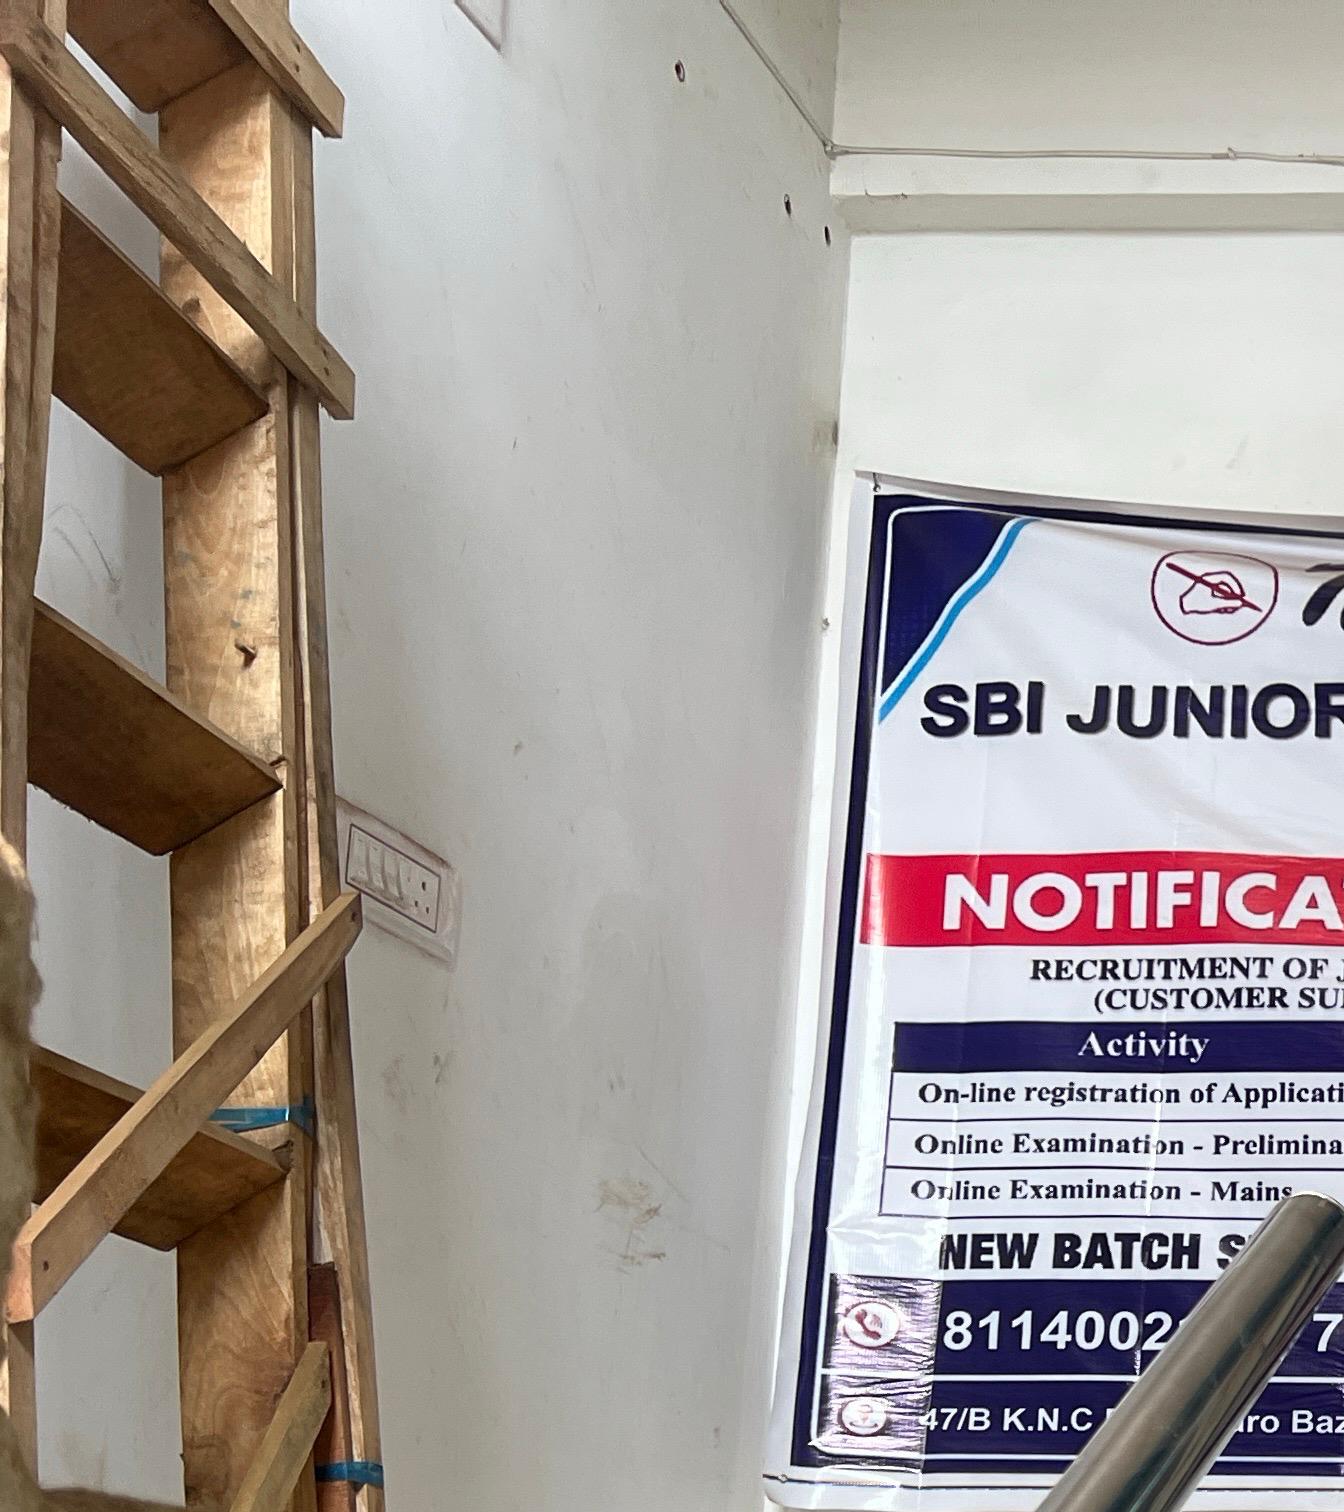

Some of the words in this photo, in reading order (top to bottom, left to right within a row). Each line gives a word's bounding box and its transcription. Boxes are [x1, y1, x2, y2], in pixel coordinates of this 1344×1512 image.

[920, 681, 1043, 737] SBI
[1030, 957, 1274, 983] RECRUITMENT
[1282, 957, 1328, 982] OF
[1093, 986, 1290, 1014] (CUSTOMER
[1078, 1030, 1210, 1063] Activity
[918, 1081, 1017, 1105] On-line
[1024, 1082, 1182, 1109] registration
[1190, 1081, 1219, 1105] of
[914, 1133, 1004, 1158] Online
[1011, 1133, 1185, 1158] Examination
[910, 1178, 1001, 1202] Online
[1009, 1178, 1181, 1202] Examination
[1210, 1180, 1293, 1202] Mains
[939, 1232, 1039, 1271] NEW
[1052, 1232, 1201, 1270] BATCH
[919, 1406, 992, 1432] 47/B
[1002, 1406, 1094, 1432] K.N.C
